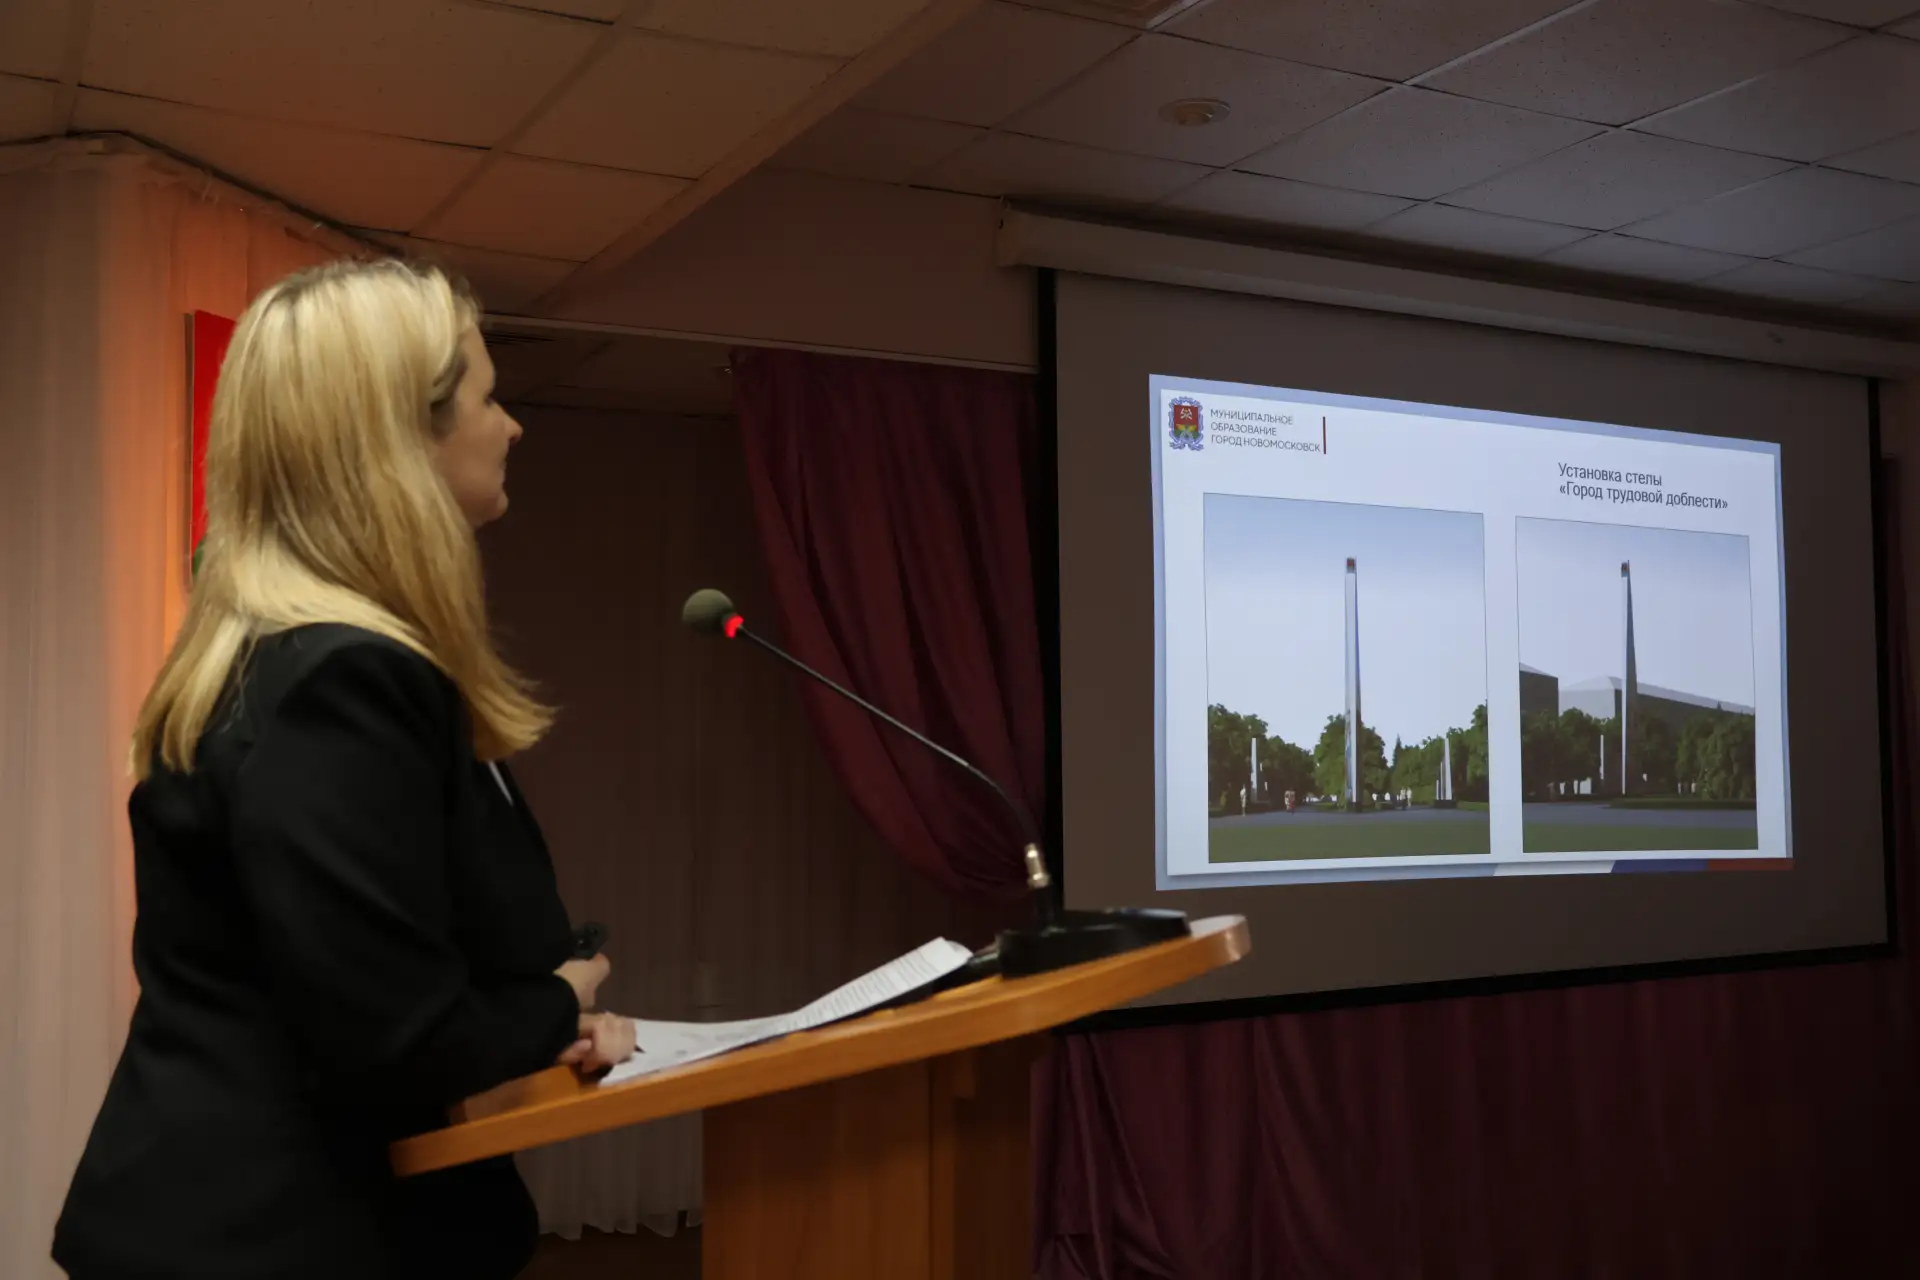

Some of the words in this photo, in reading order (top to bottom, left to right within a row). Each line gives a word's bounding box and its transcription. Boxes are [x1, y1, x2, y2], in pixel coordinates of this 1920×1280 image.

[1210, 409, 1293, 425] МУНИЦИПАЛЬНОЕ
[1210, 422, 1277, 436] ОБРАЗОВАНИЕ
[1211, 434, 1242, 447] ГОРОД
[1243, 437, 1320, 452] НОВОМОСКОВСК
[1558, 462, 1622, 483] Установка
[1625, 471, 1662, 486] стелы
[1559, 481, 1603, 500] «Город
[1607, 487, 1663, 504] трудовой
[1666, 492, 1728, 509] доблести»
